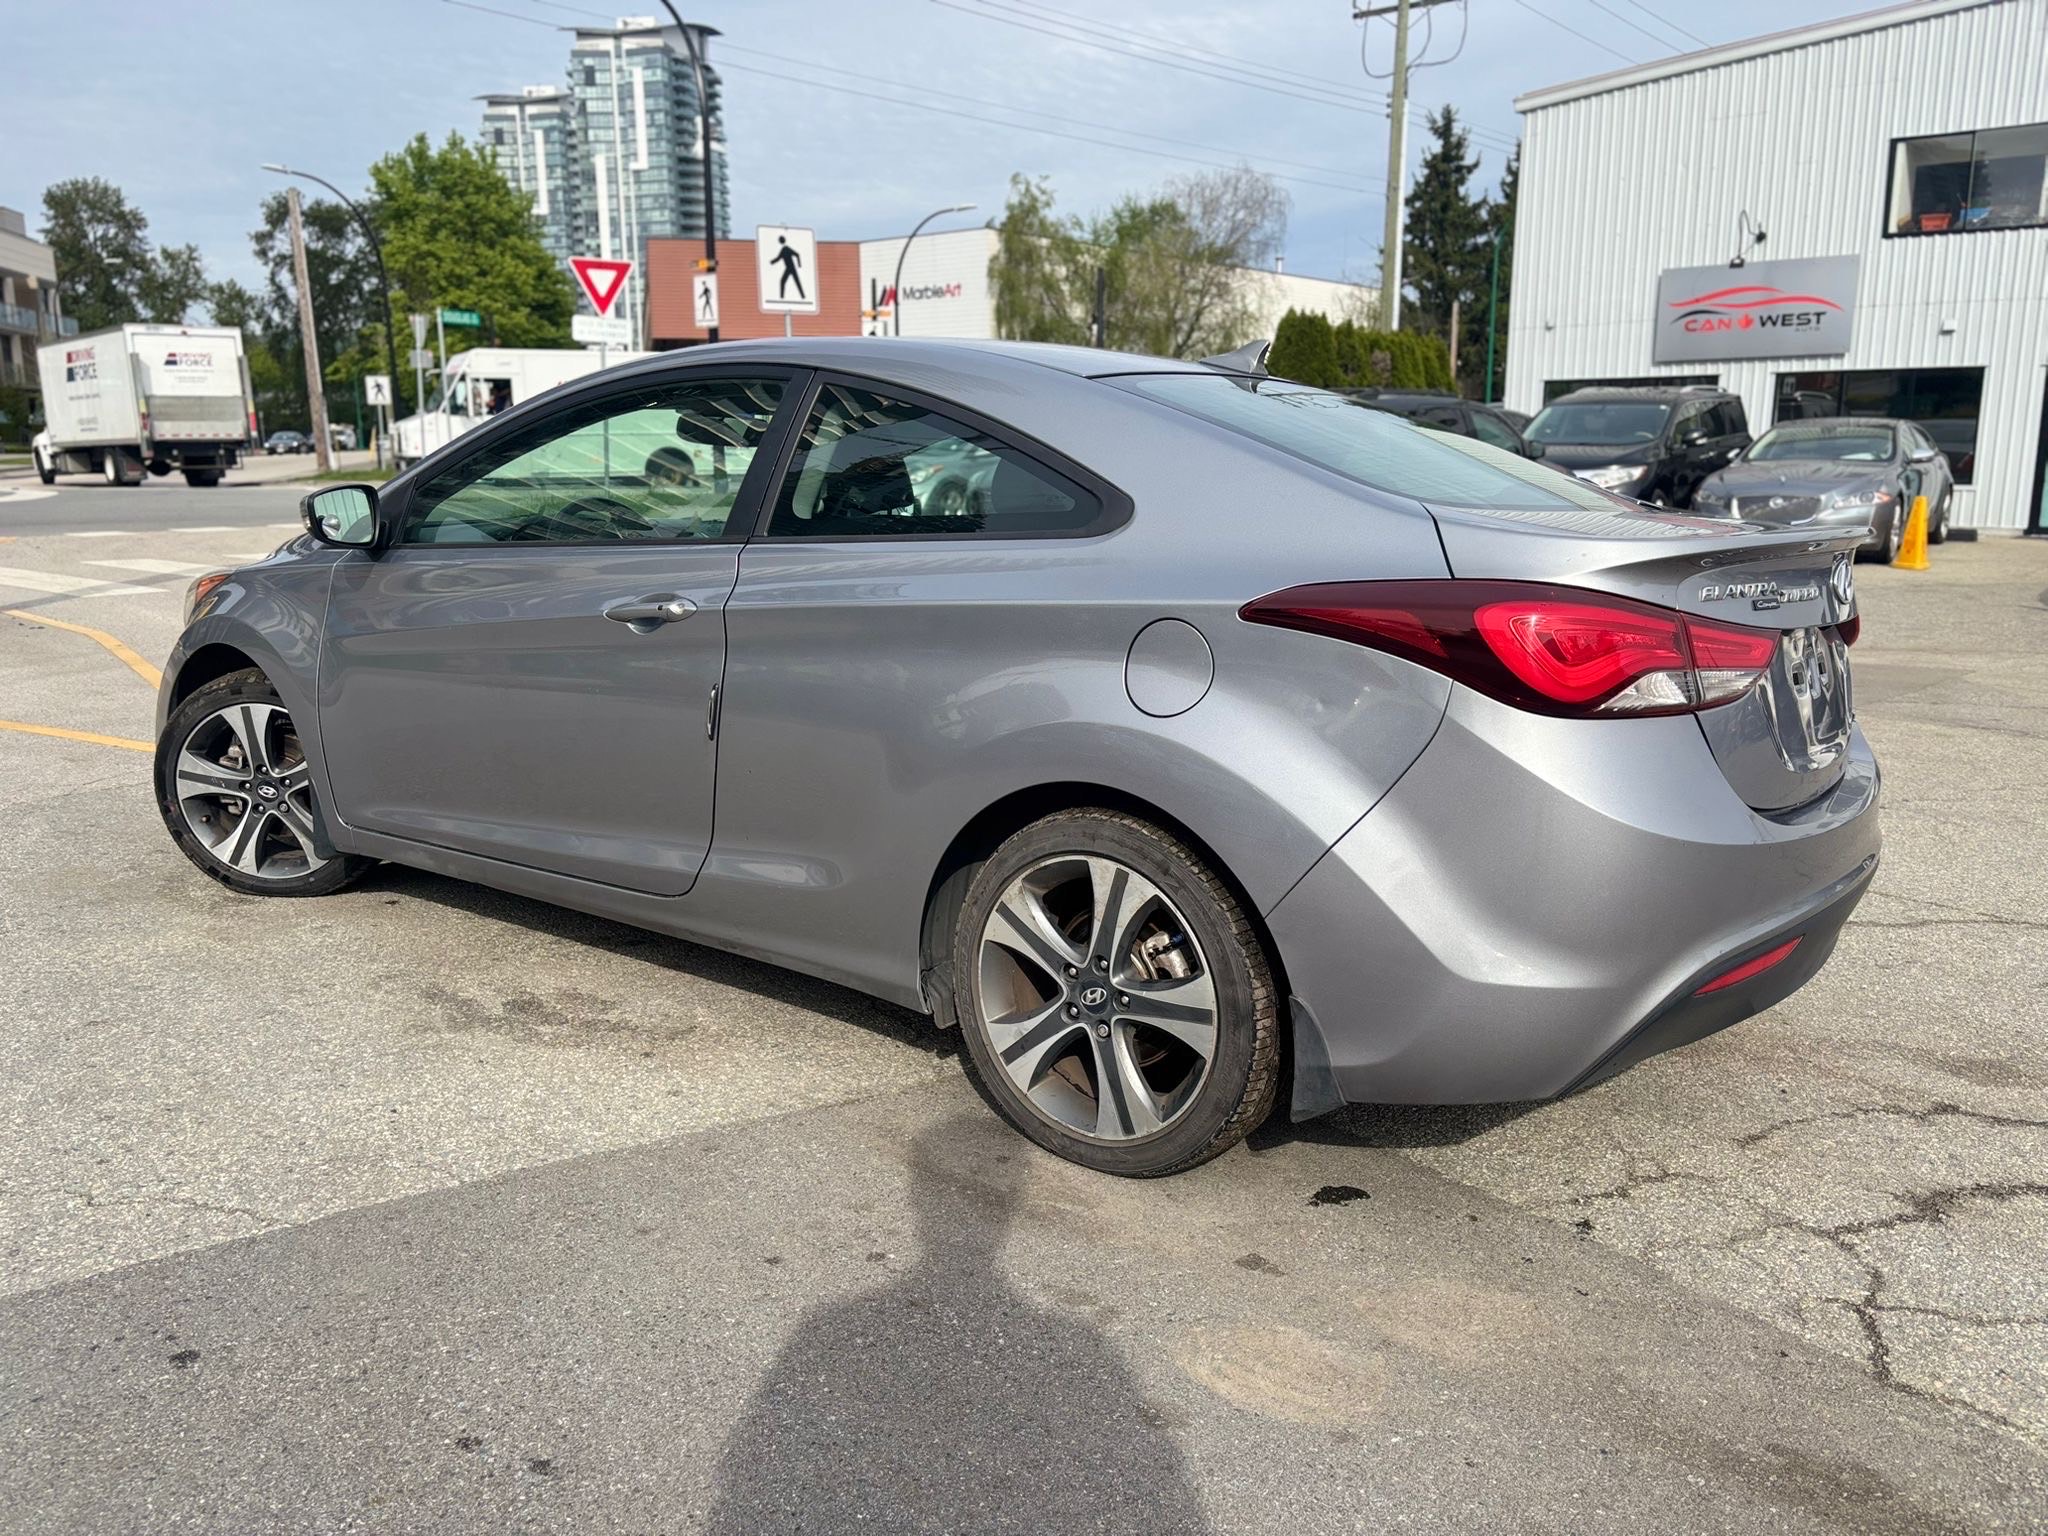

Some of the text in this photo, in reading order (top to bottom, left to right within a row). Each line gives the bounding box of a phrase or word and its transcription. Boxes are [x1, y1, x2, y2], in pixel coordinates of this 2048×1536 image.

[903, 284, 961, 300] MarbleArt
[1684, 312, 1826, 332] CAN WEST
[178, 358, 213, 366] FORCE
[1702, 582, 1778, 601] ELANTRA
